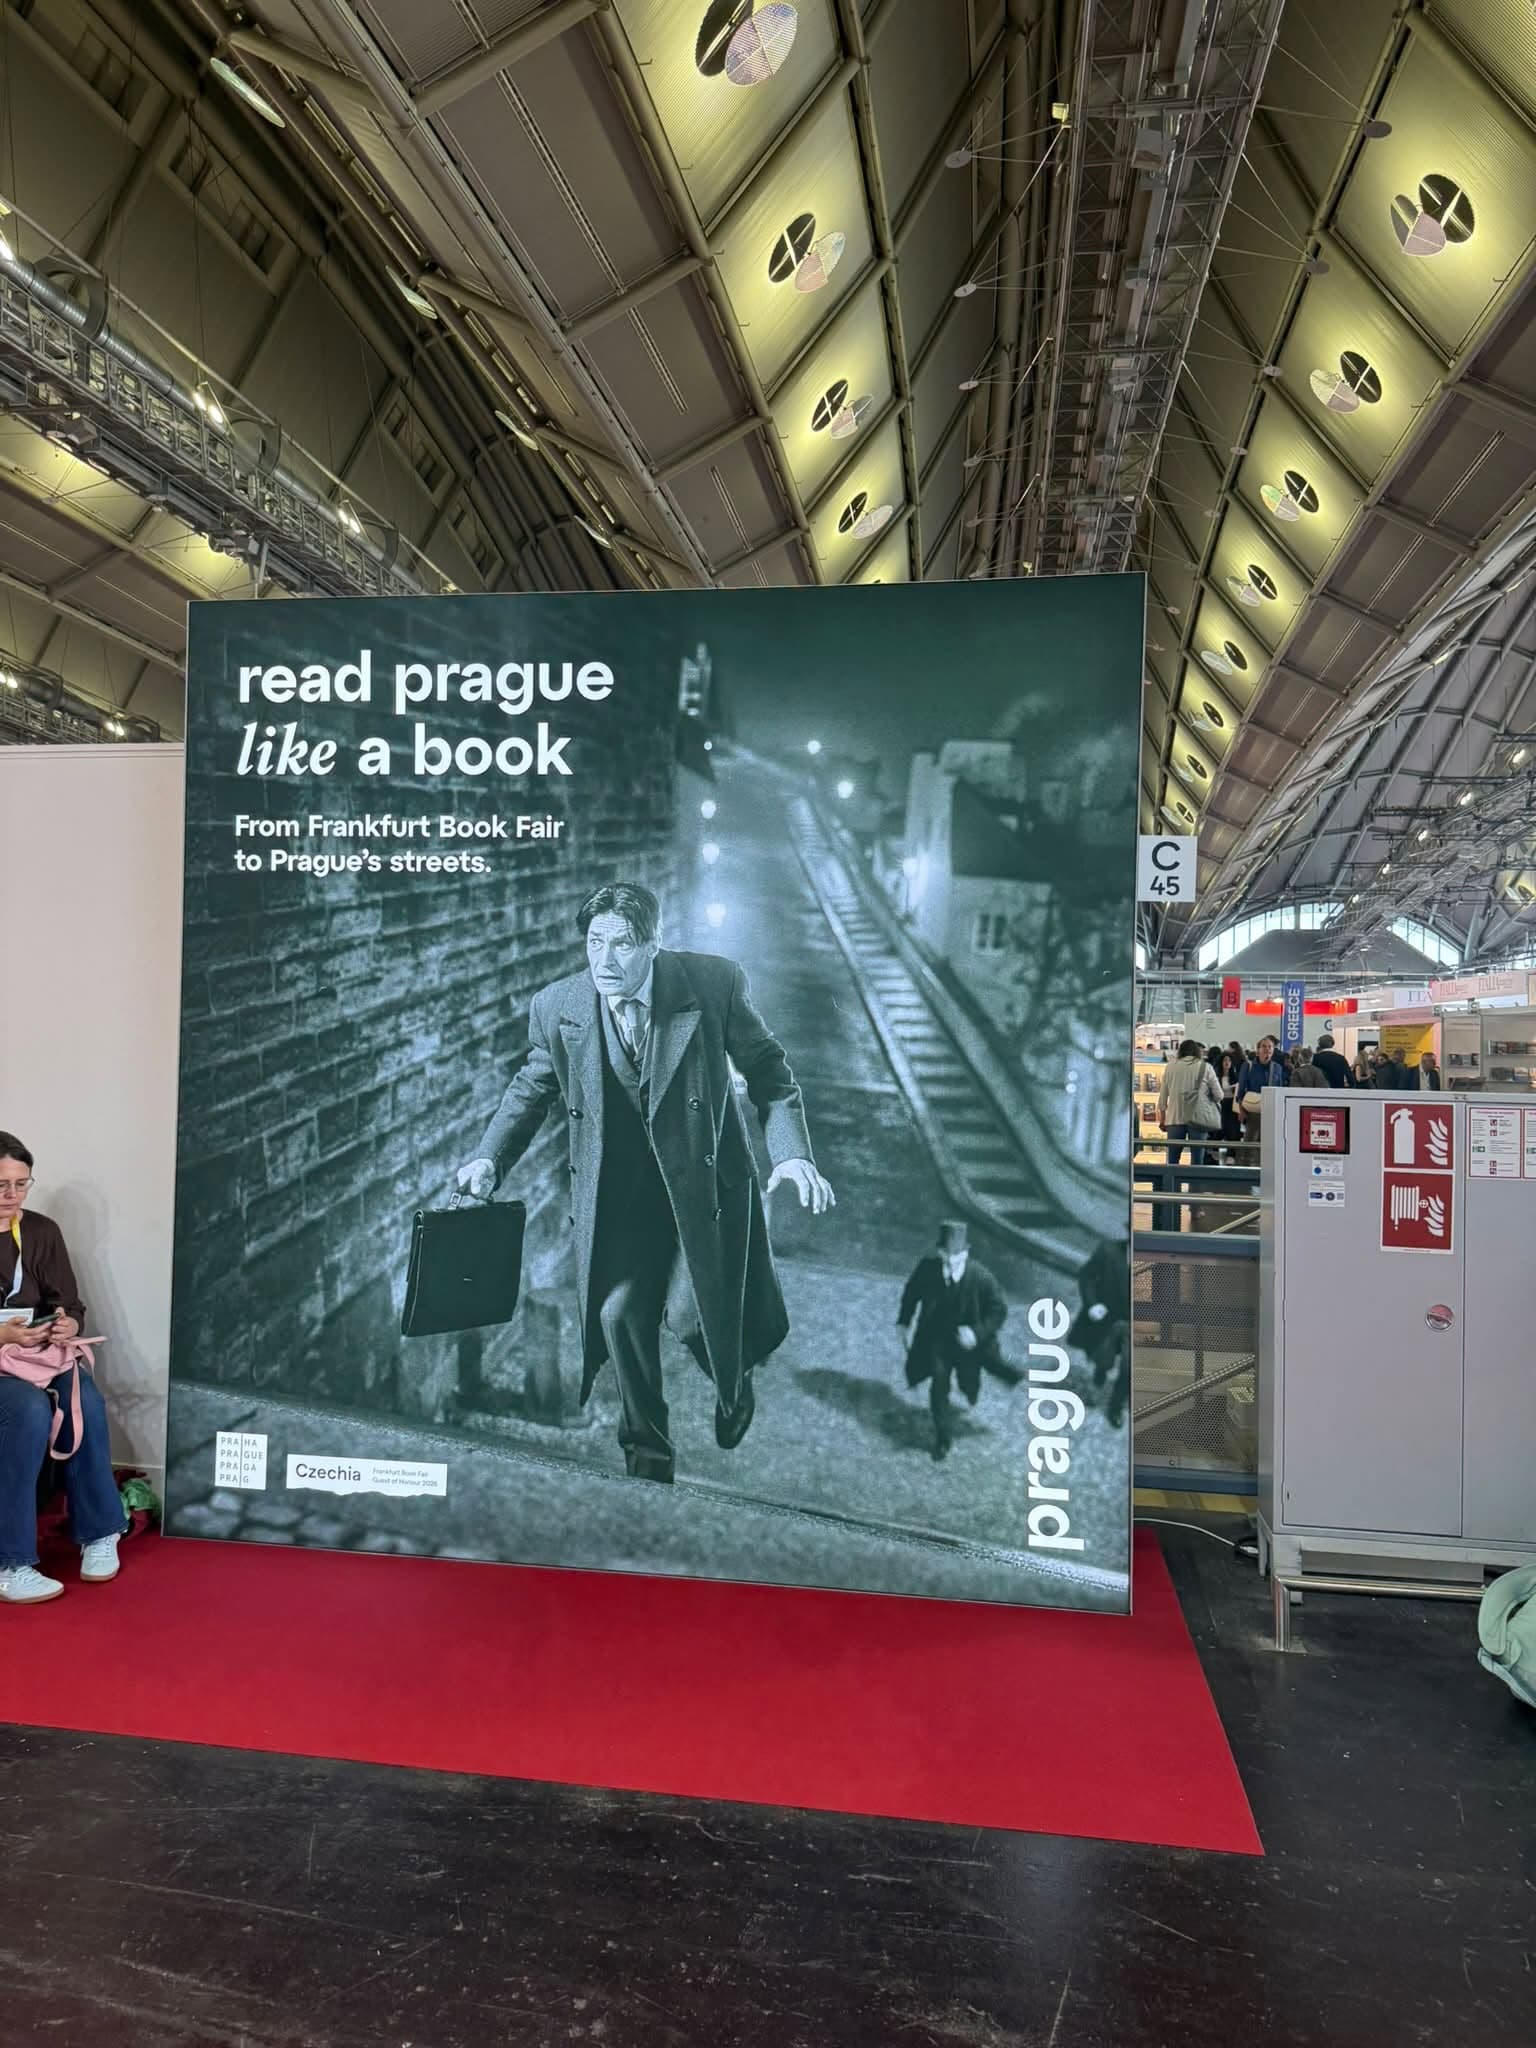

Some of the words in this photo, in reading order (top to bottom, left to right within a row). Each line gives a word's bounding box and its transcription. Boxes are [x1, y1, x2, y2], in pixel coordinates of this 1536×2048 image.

[238, 649, 372, 704] read
[394, 658, 615, 716] prague
[236, 721, 338, 776] like
[357, 736, 391, 776] a
[413, 722, 574, 776] book
[234, 814, 300, 838] From
[308, 814, 431, 838] Frankfurt
[439, 815, 508, 839] Book
[516, 816, 565, 839] Fair
[234, 851, 263, 871] to
[270, 850, 382, 878] Prague’s
[389, 853, 492, 874] streets.
[1151, 840, 1181, 871] C
[1149, 875, 1180, 896] 45
[1287, 987, 1300, 1041] GREECE
[1027, 1297, 1086, 1551] prague
[295, 1463, 361, 1482] Czechia
